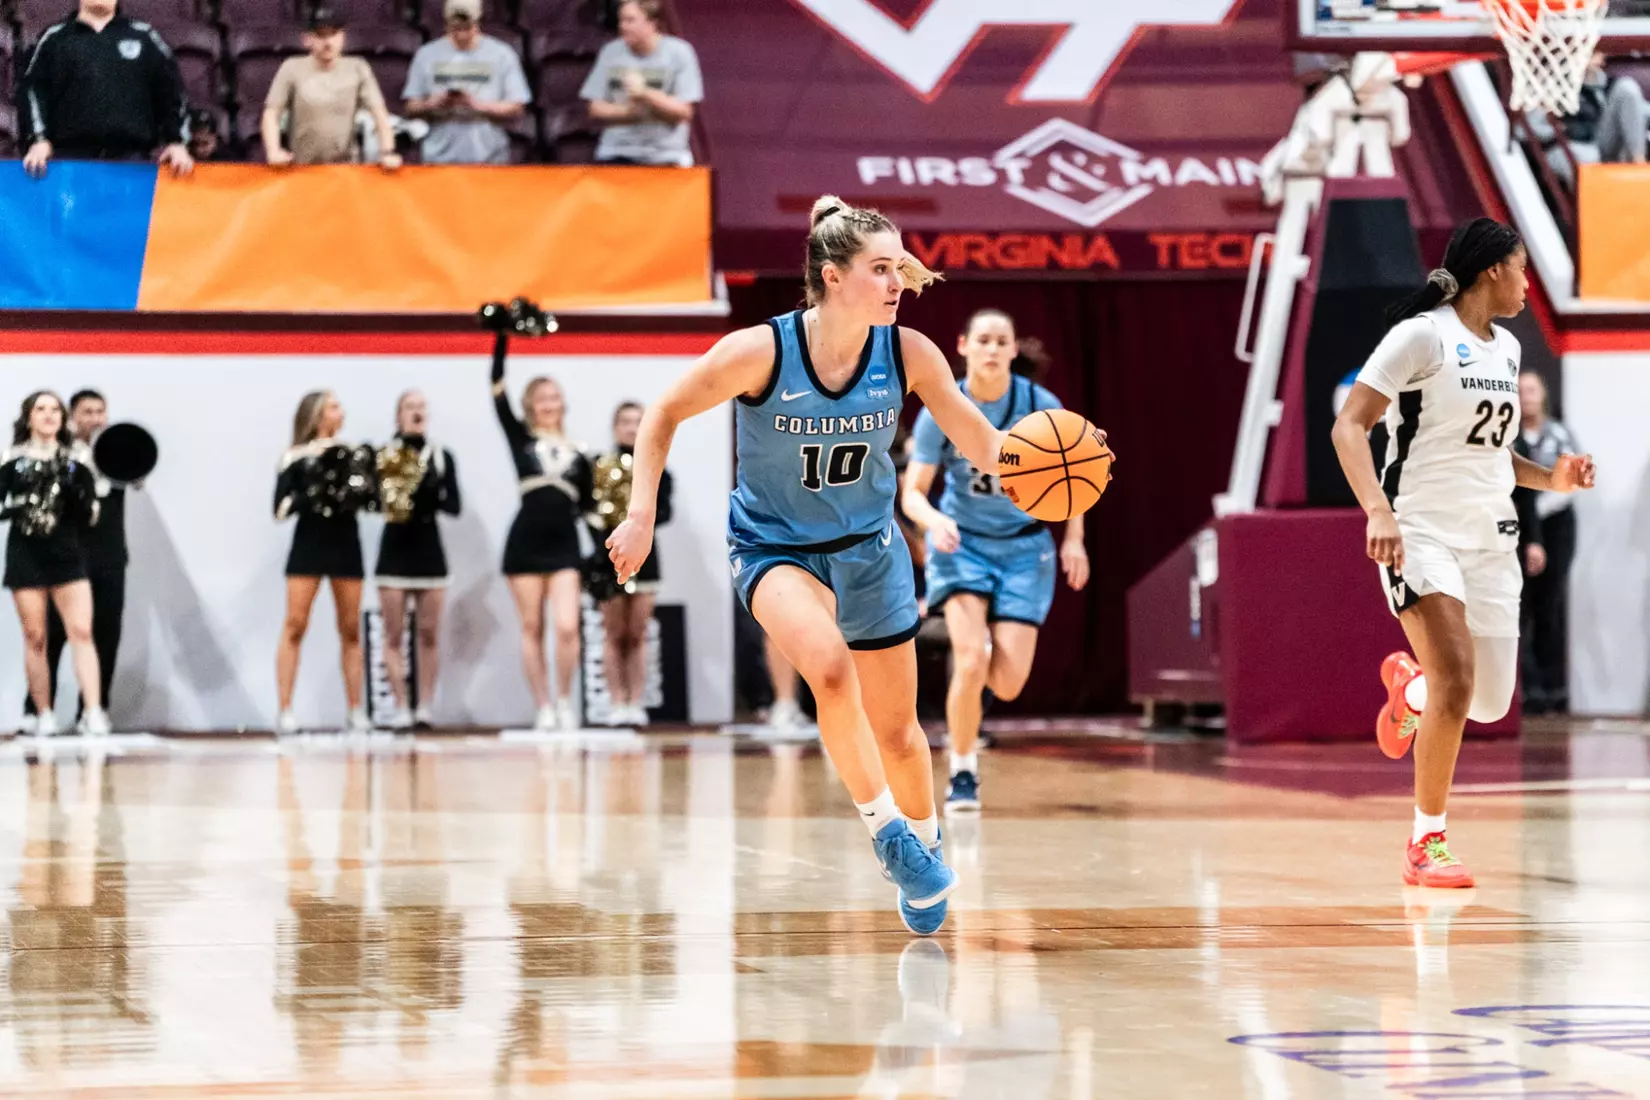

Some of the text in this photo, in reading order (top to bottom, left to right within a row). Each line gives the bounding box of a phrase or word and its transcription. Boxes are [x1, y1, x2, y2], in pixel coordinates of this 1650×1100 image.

[795, 0, 1241, 103] VT
[857, 155, 1032, 186] FIRST
[908, 232, 1121, 269] VIRGINIA
[774, 406, 896, 435] COLUMBIA
[1466, 399, 1514, 448] 23
[800, 442, 871, 492] 10
